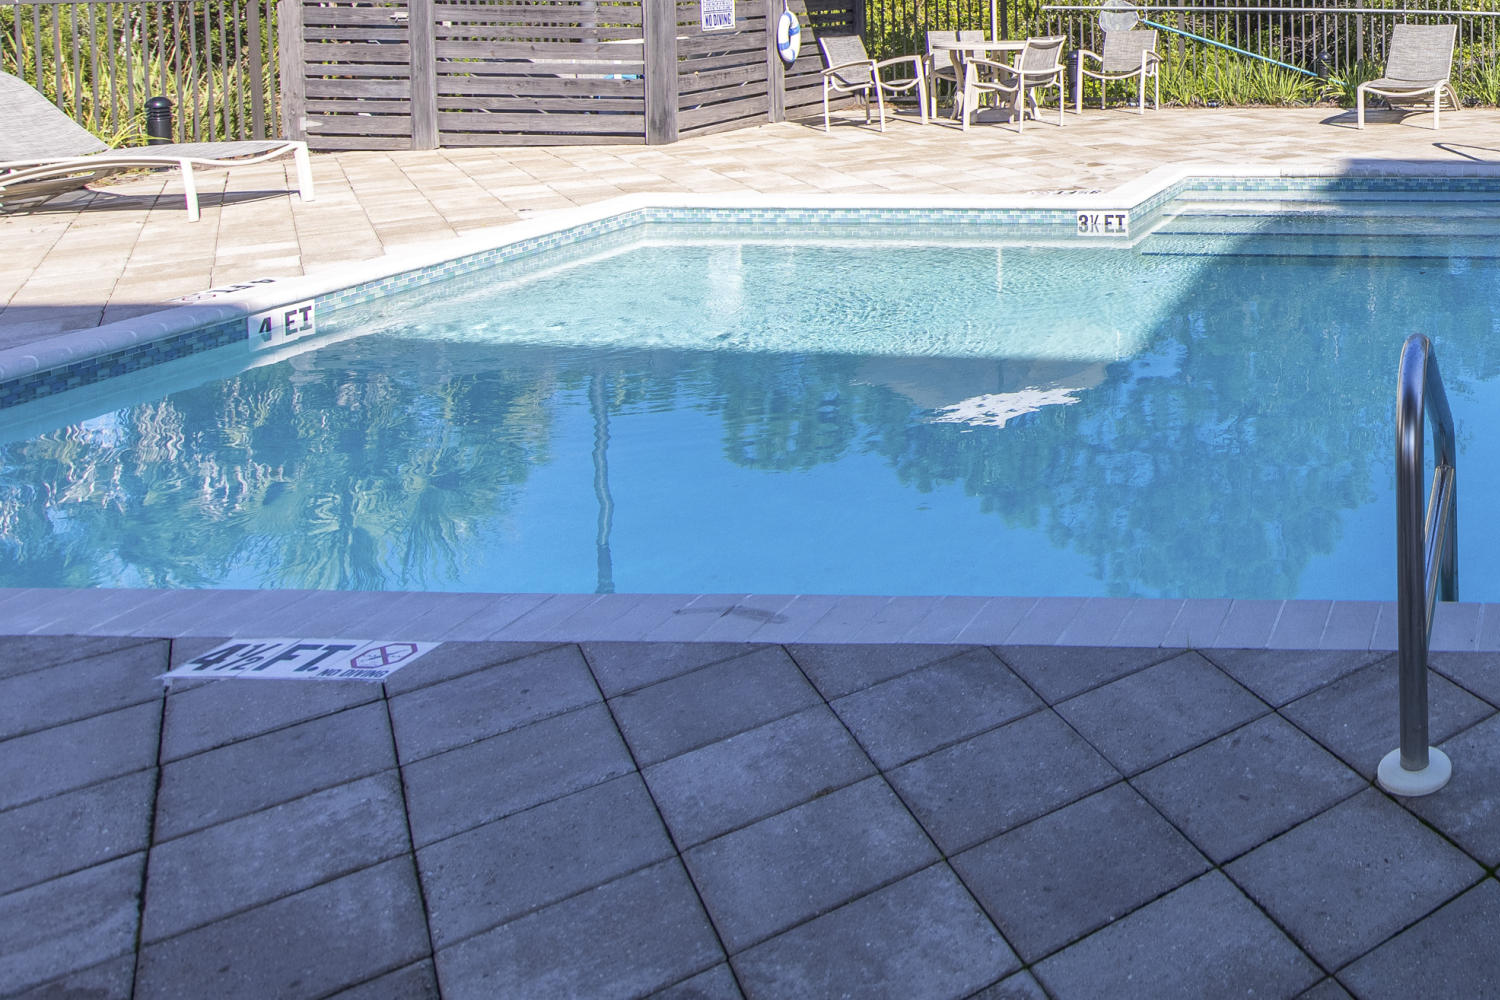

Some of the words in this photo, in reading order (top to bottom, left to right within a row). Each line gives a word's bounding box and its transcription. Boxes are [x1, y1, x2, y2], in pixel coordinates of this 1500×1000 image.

[705, 14, 712, 27] NO
[713, 12, 731, 26] DIVING
[317, 668, 342, 677] NO
[339, 668, 389, 678] DIVING
